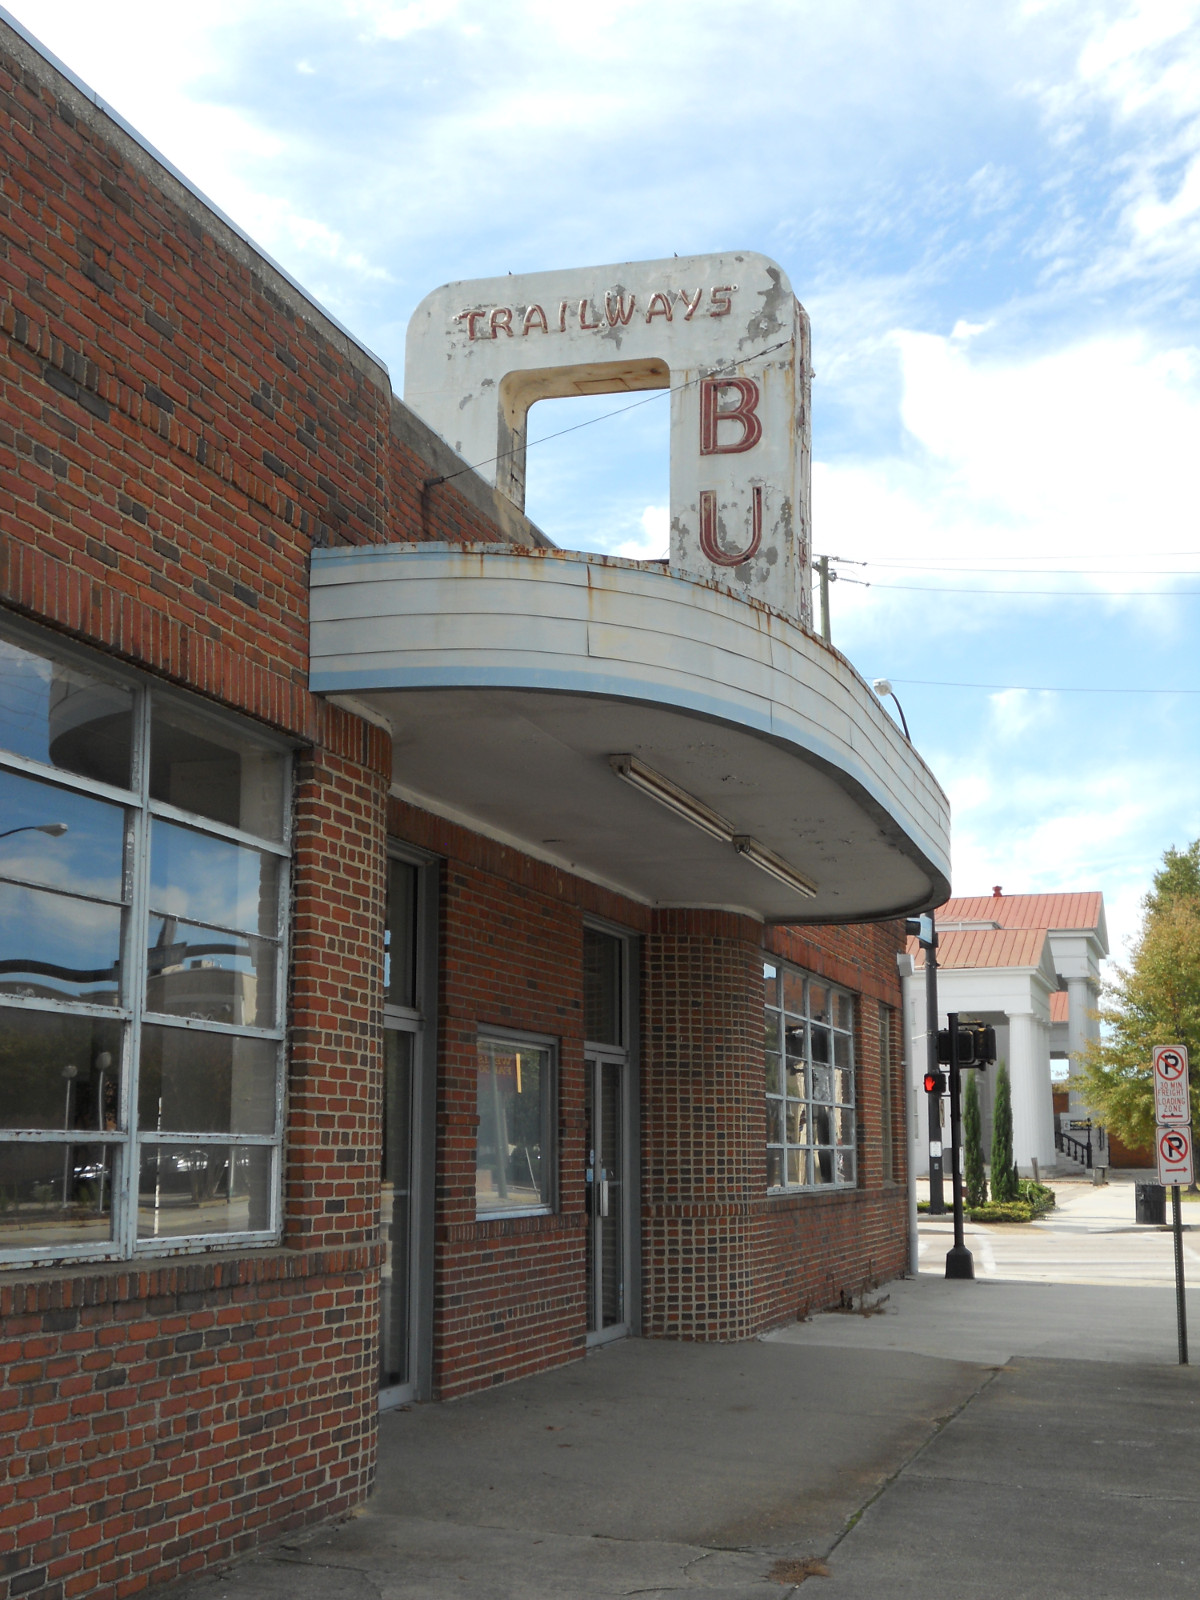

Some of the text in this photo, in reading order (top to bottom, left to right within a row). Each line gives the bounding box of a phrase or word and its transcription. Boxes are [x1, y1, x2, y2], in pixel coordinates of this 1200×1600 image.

[453, 285, 738, 340] TRAILWAYS
[1160, 1081, 1183, 1090] 30 MIN
[1157, 1089, 1184, 1097] FREIGHT
[1157, 1098, 1186, 1106] LOADING
[1163, 1105, 1183, 1113] ZONE
